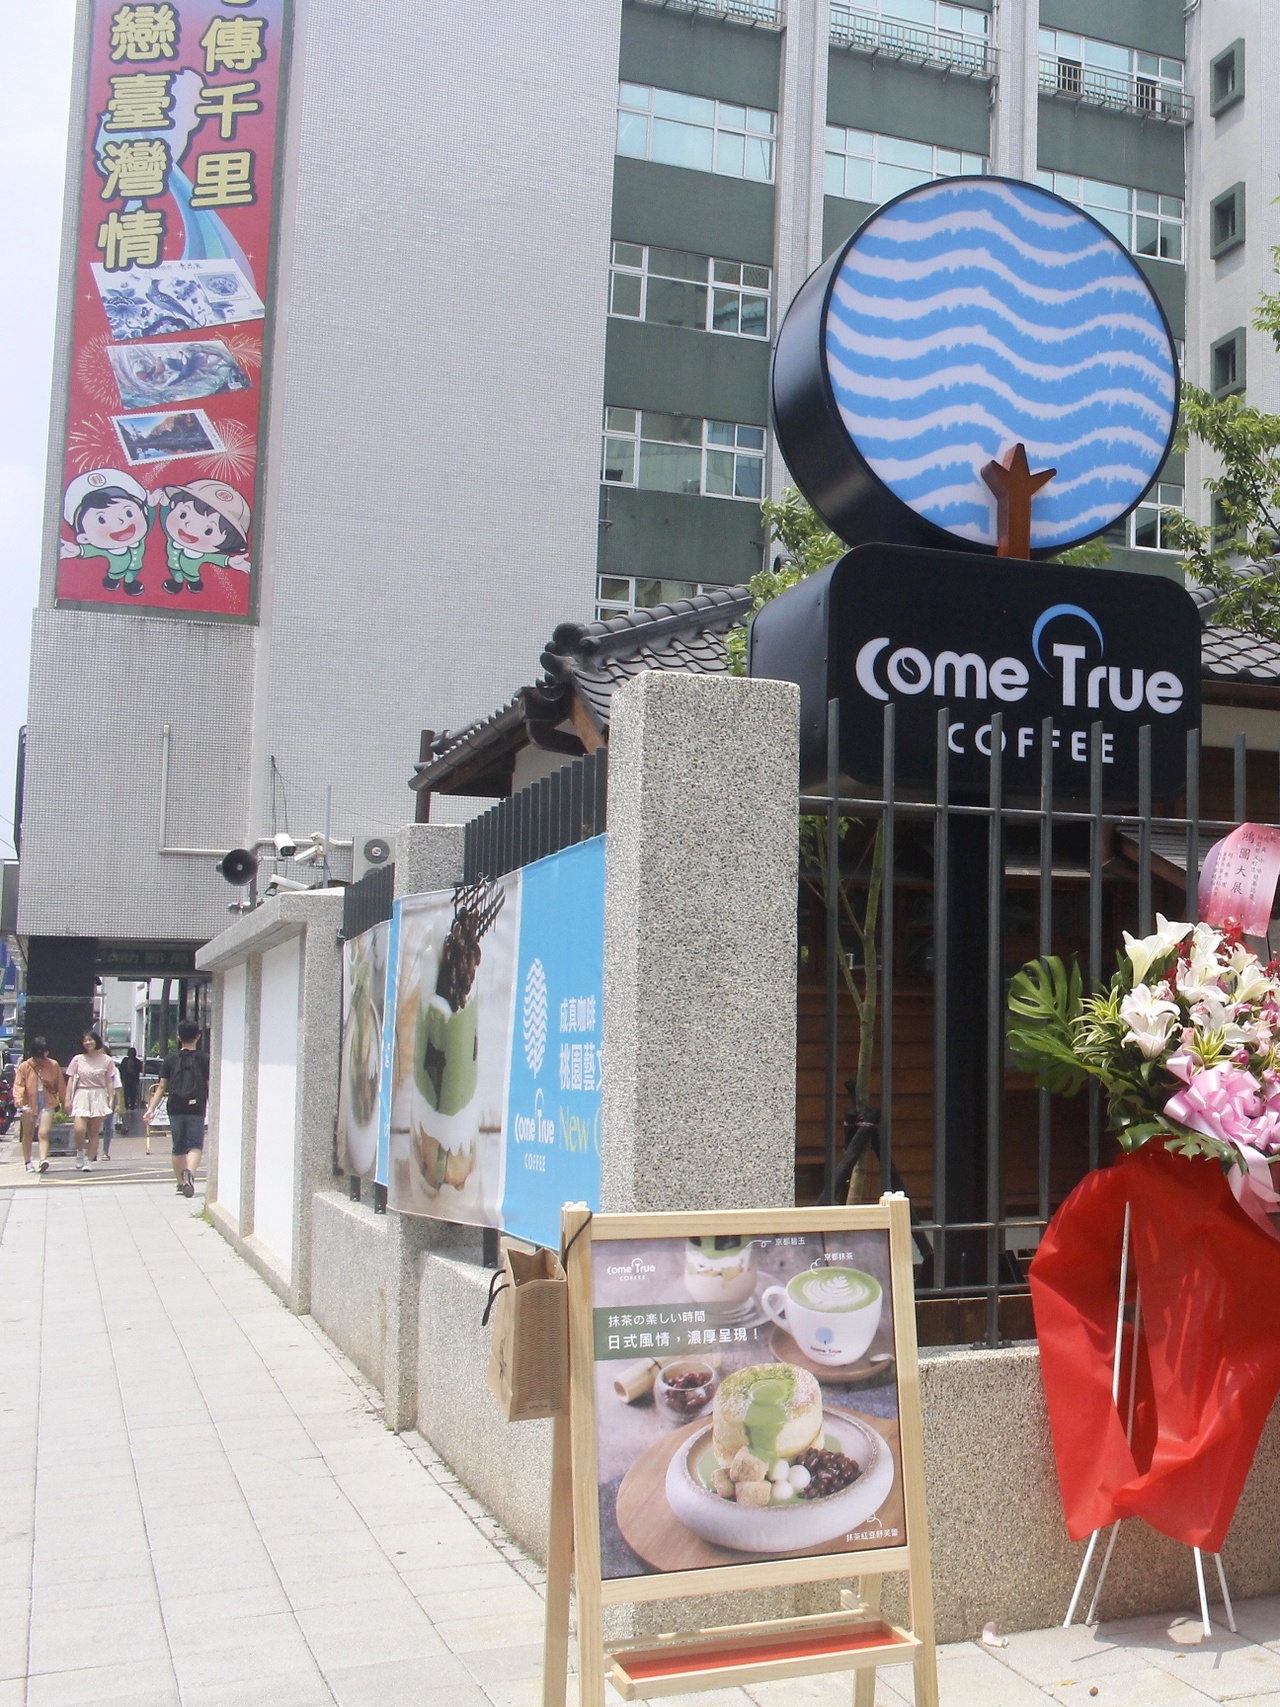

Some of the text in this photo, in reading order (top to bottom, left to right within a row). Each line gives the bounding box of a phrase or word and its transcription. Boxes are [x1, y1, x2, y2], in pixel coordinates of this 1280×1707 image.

[190, 0, 263, 208] 傳千里
[98, 6, 176, 269] 戀臺灣情
[855, 637, 1184, 714] Come True
[1231, 831, 1255, 895] 鴻圖大展
[560, 995, 596, 1033] 成真咖啡
[515, 1109, 554, 1144] Come True
[560, 1105, 590, 1153] New
[524, 1153, 546, 1172] COFFEE
[607, 1263, 655, 1275] Come True
[608, 1310, 706, 1328] 抹茶の楽しい時間
